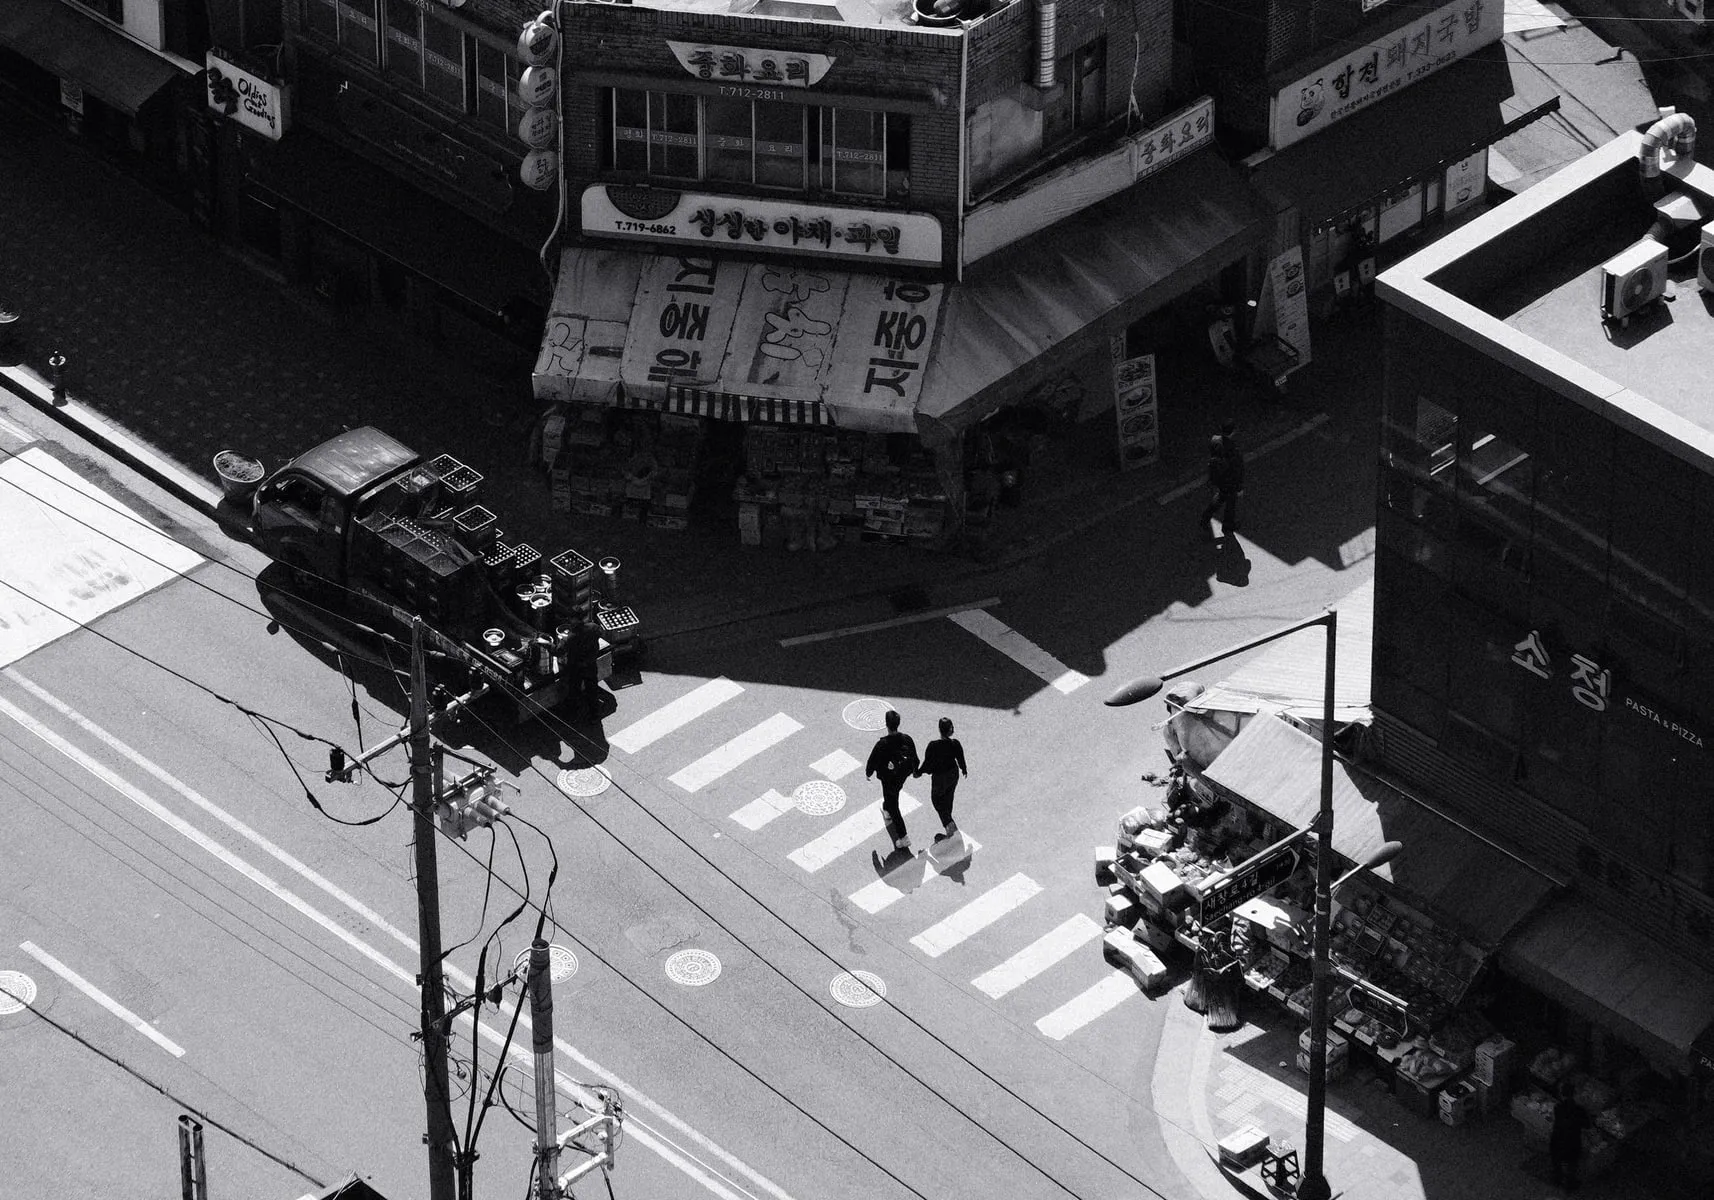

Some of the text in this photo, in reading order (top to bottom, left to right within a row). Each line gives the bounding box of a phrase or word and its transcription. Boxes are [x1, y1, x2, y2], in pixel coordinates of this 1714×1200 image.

[687, 48, 809, 88] 중화요리
[1331, 51, 1379, 99] 합천
[238, 78, 267, 107] Oldies
[719, 86, 785, 101] T.712-2811
[244, 98, 276, 129] Goodies
[1140, 108, 1210, 165] 중화요리
[615, 220, 677, 235] T.719-6862
[1511, 629, 1613, 713] 소정
[1624, 697, 1661, 728] PASTA
[1670, 722, 1704, 749] PIZZA
